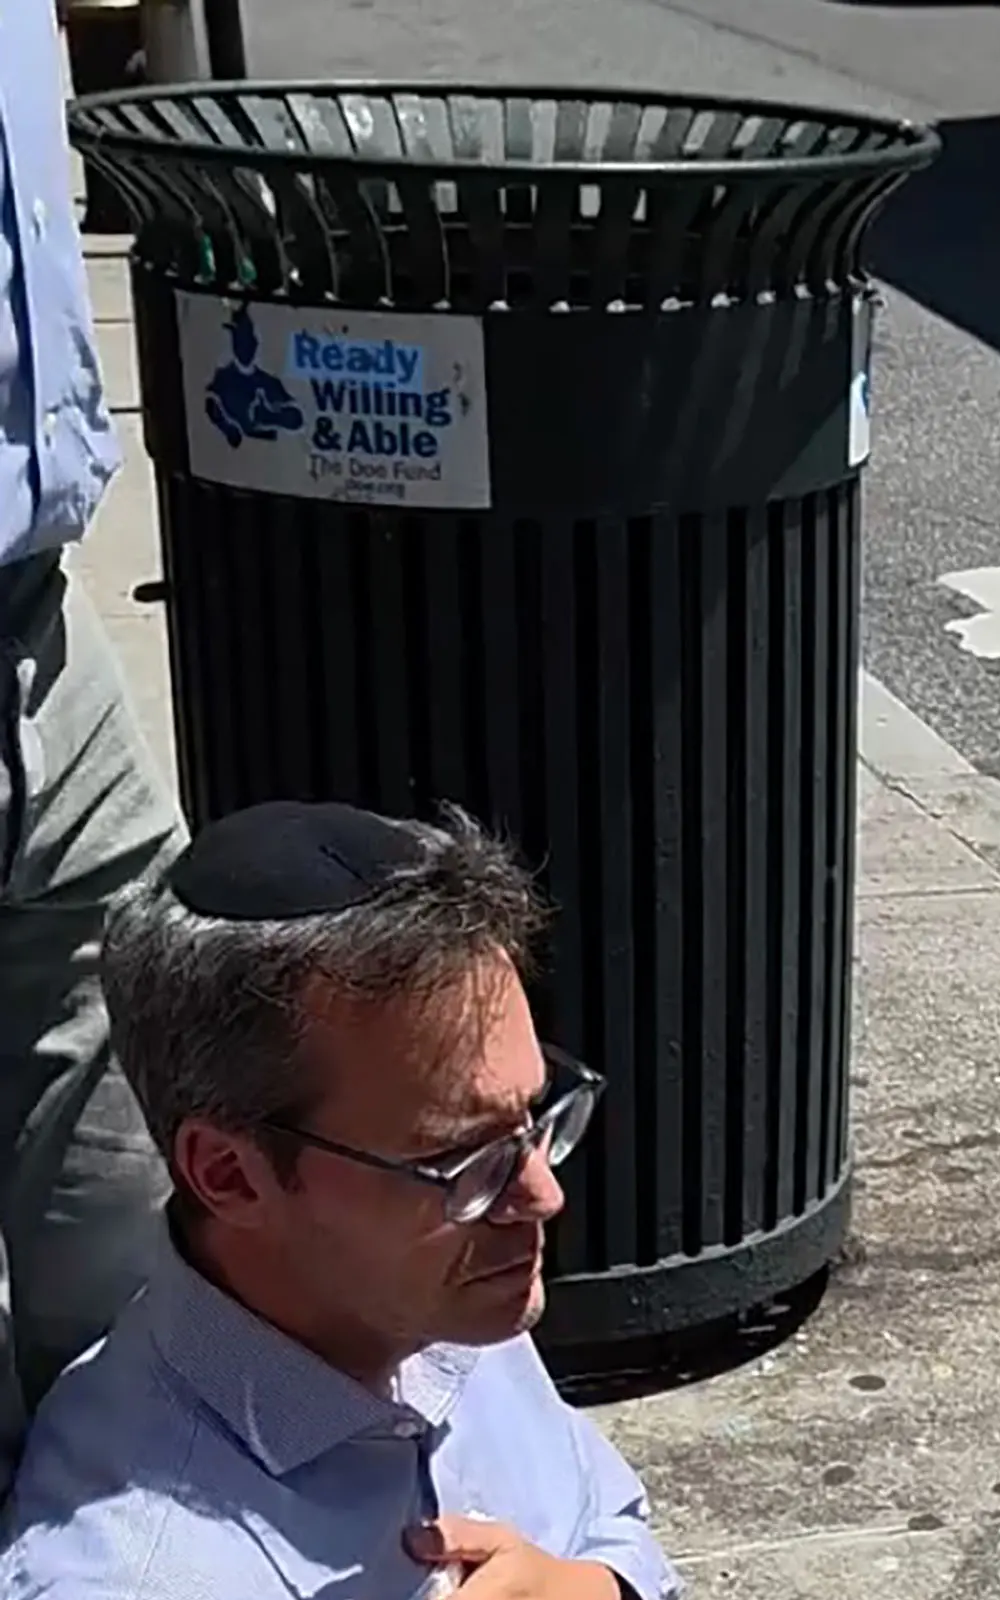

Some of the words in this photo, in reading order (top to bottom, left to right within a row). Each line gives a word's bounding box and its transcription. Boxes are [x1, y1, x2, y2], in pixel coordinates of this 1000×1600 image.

[294, 331, 419, 383] Ready
[310, 378, 452, 426] Willing
[347, 420, 438, 458] Able
[309, 454, 342, 480] The
[349, 458, 387, 478] Doe
[393, 460, 441, 481] Fund
